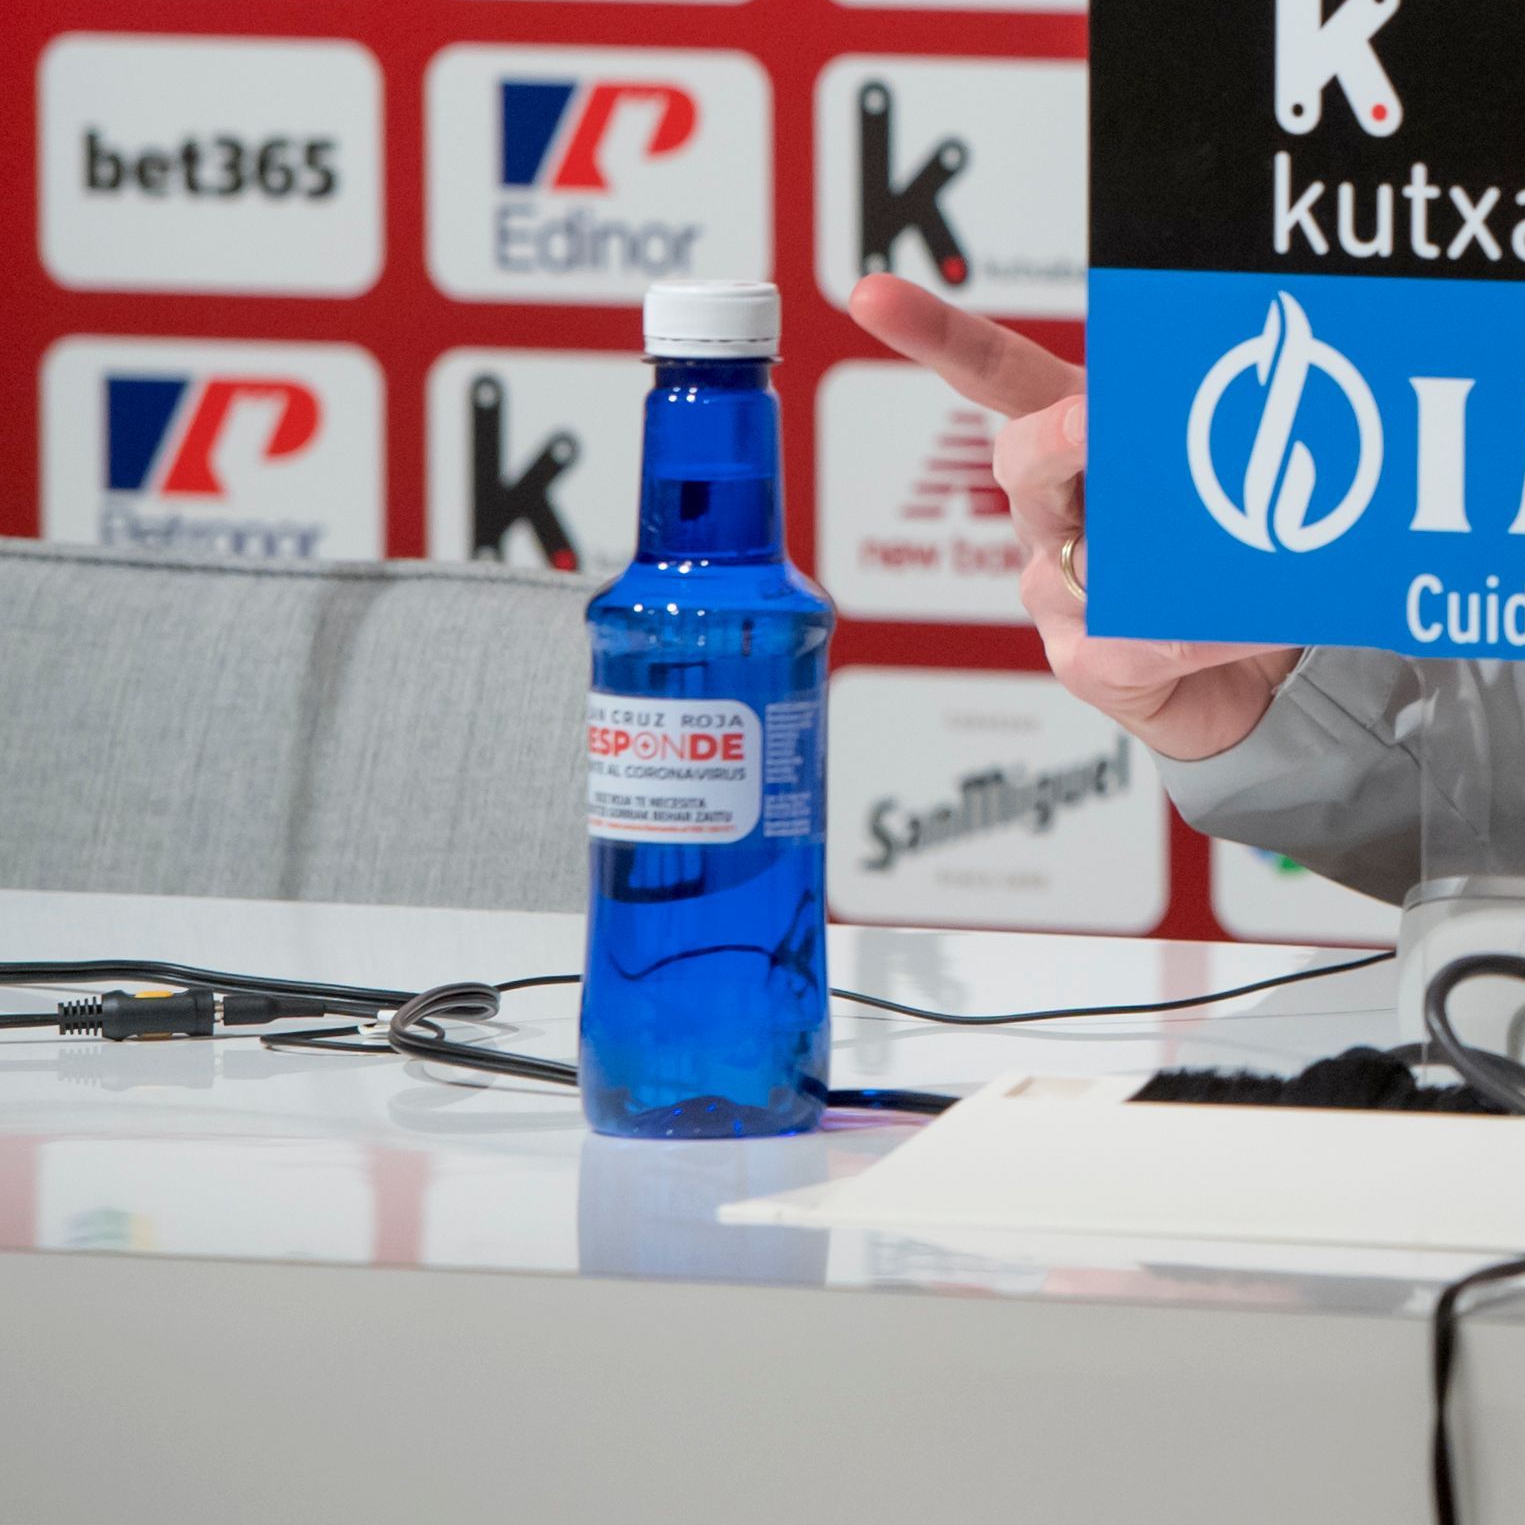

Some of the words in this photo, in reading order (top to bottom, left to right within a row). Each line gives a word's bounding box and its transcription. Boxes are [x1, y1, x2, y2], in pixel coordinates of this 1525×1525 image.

[82, 127, 339, 202] bet365
[493, 201, 702, 278] Edinor
[588, 726, 746, 762] ESPONDE
[610, 708, 666, 728] CRUZ
[680, 713, 746, 729] ROJA
